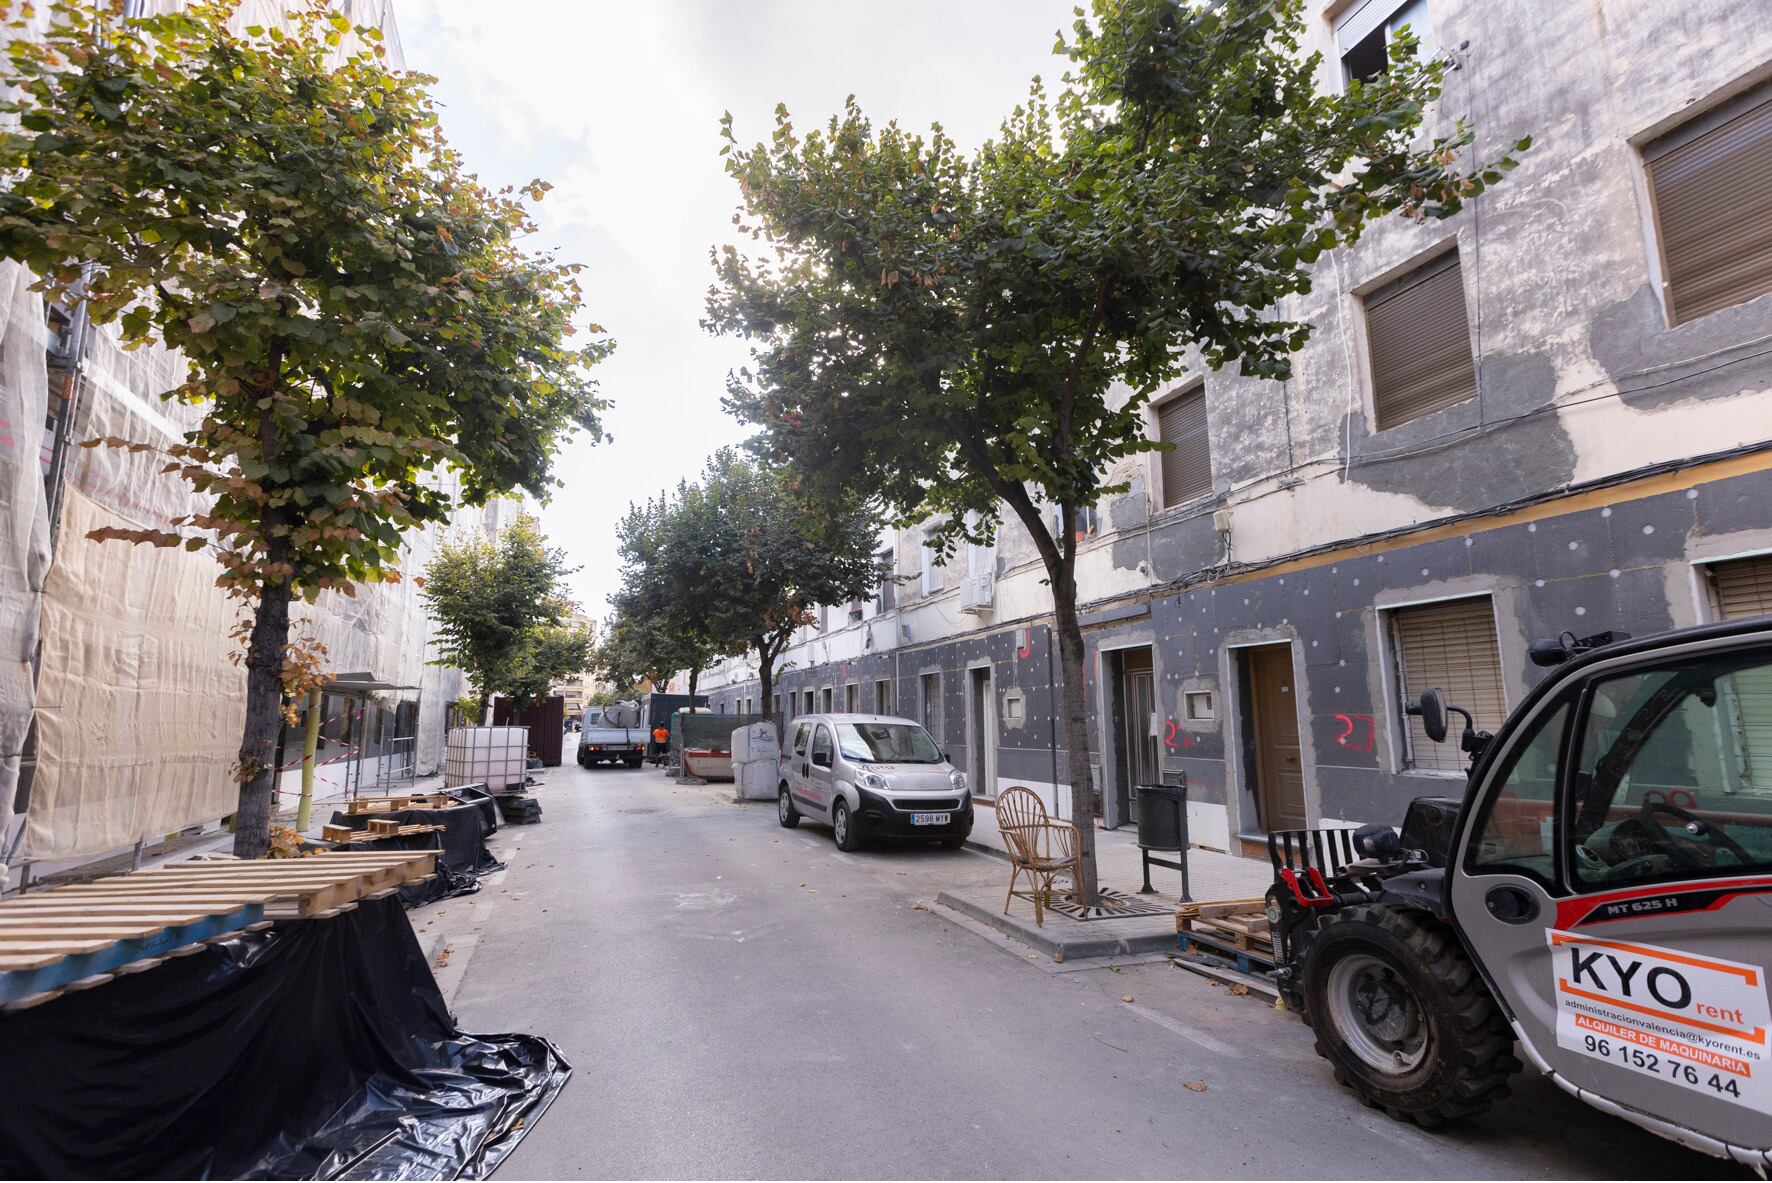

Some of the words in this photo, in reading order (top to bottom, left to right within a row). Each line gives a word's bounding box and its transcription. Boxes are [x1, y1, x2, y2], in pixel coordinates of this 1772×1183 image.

[1607, 904, 1629, 915] MT
[1631, 899, 1663, 911] 625
[1665, 897, 1678, 908] H
[1570, 946, 1692, 1010] KYO
[1696, 1002, 1744, 1024] rent
[1564, 1000, 1760, 1060] administracionvalencia@kyorent.es
[1577, 1016, 1637, 1041] ALQUILER
[1639, 1032, 1657, 1047] DE
[1659, 1040, 1748, 1073] MAQUINARIA
[1584, 1035, 1610, 1057] 96
[1619, 1045, 1660, 1073] 152
[1667, 1060, 1699, 1085] 76
[1707, 1073, 1741, 1098] 44
